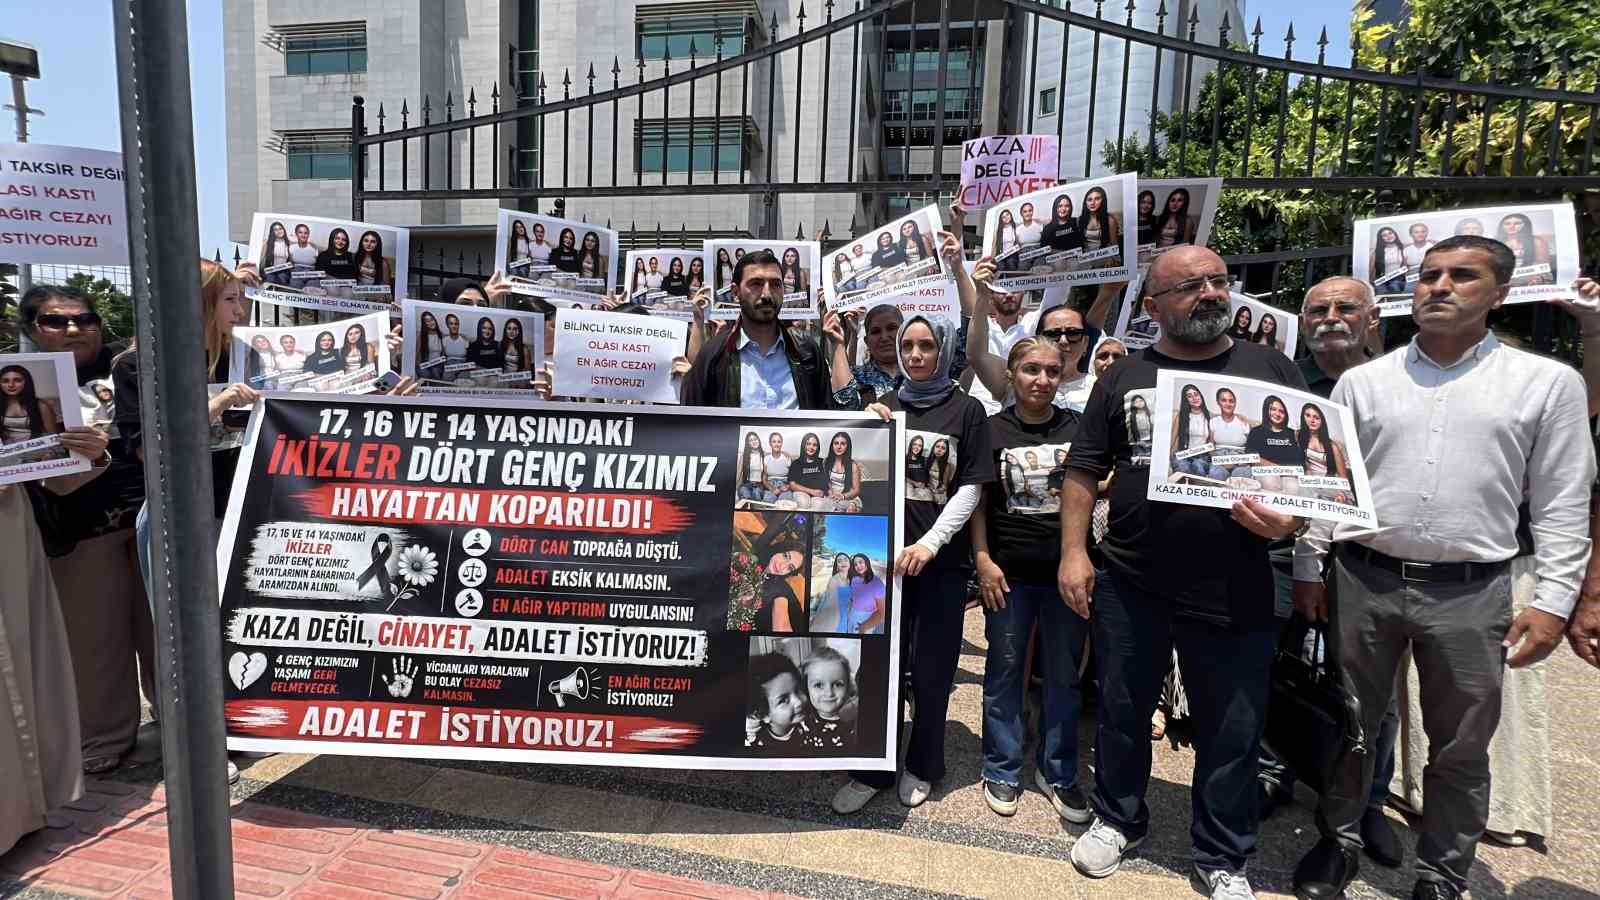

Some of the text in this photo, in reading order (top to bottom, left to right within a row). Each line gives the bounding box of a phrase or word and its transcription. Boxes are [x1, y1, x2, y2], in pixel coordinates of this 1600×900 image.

[964, 136, 1025, 161] KAZA
[8, 160, 74, 176] TAKSİR
[974, 158, 1036, 179] DEĞİL
[43, 186, 96, 201] KASTI
[49, 211, 112, 225] CEZAYI
[0, 231, 98, 248] STİYORUZ!
[1066, 272, 1097, 281] OLMAYA
[919, 288, 945, 297] KASTI
[918, 303, 950, 312] CEZAYI
[563, 319, 605, 334] BİLİNÇLİ
[608, 323, 644, 337] TAKSİR
[588, 339, 650, 353] OLASI KASTI
[576, 356, 657, 371] EN AĞIR CEZAYI
[319, 408, 634, 447] 17, 16 VE 14 YAŞINDAKİ
[267, 432, 718, 493] İKİZLER DÖRT GENÇ KIZIMIZ
[1155, 484, 1184, 496] KAZA
[1272, 496, 1316, 509] ADALET
[331, 487, 654, 529] HAYATTAN KOPARILDI!
[280, 528, 289, 539] 16
[291, 528, 304, 540] VE
[305, 530, 316, 540] 14
[318, 530, 367, 544] YAŞINDAKİ
[284, 541, 333, 556] İKİZLER
[499, 535, 683, 563] DÖRT CAN TOPRAĞA DÜŞTÜ.
[267, 554, 351, 568] DÖRT GENÇ KIZIMIZ
[253, 566, 356, 581] HAYATLARININ BAHARINDA
[495, 567, 672, 592] ADALET EKSİK KALMASIN.
[258, 579, 341, 593] ARAMIZDAN ALINDI.
[492, 595, 695, 623] EN AĞIR YAPTIRIM UYGULANSIN!
[242, 613, 697, 661] KAZA DEĞİL, CİNAYET, ADALET İSTİYORUZ!
[275, 654, 360, 669] 4 GENÇ KIZIMIZIN
[425, 660, 530, 678] VİCDANLARI YARALAYAN
[273, 667, 338, 681] YAŞAMI GERİ
[607, 673, 692, 691] EN AĞIR CEZAYI
[424, 675, 503, 690] BU OLAY CEZASIZ
[606, 688, 675, 707] İSTİYORUZ!
[298, 705, 615, 748] ADALET İSTİYORUZ!
